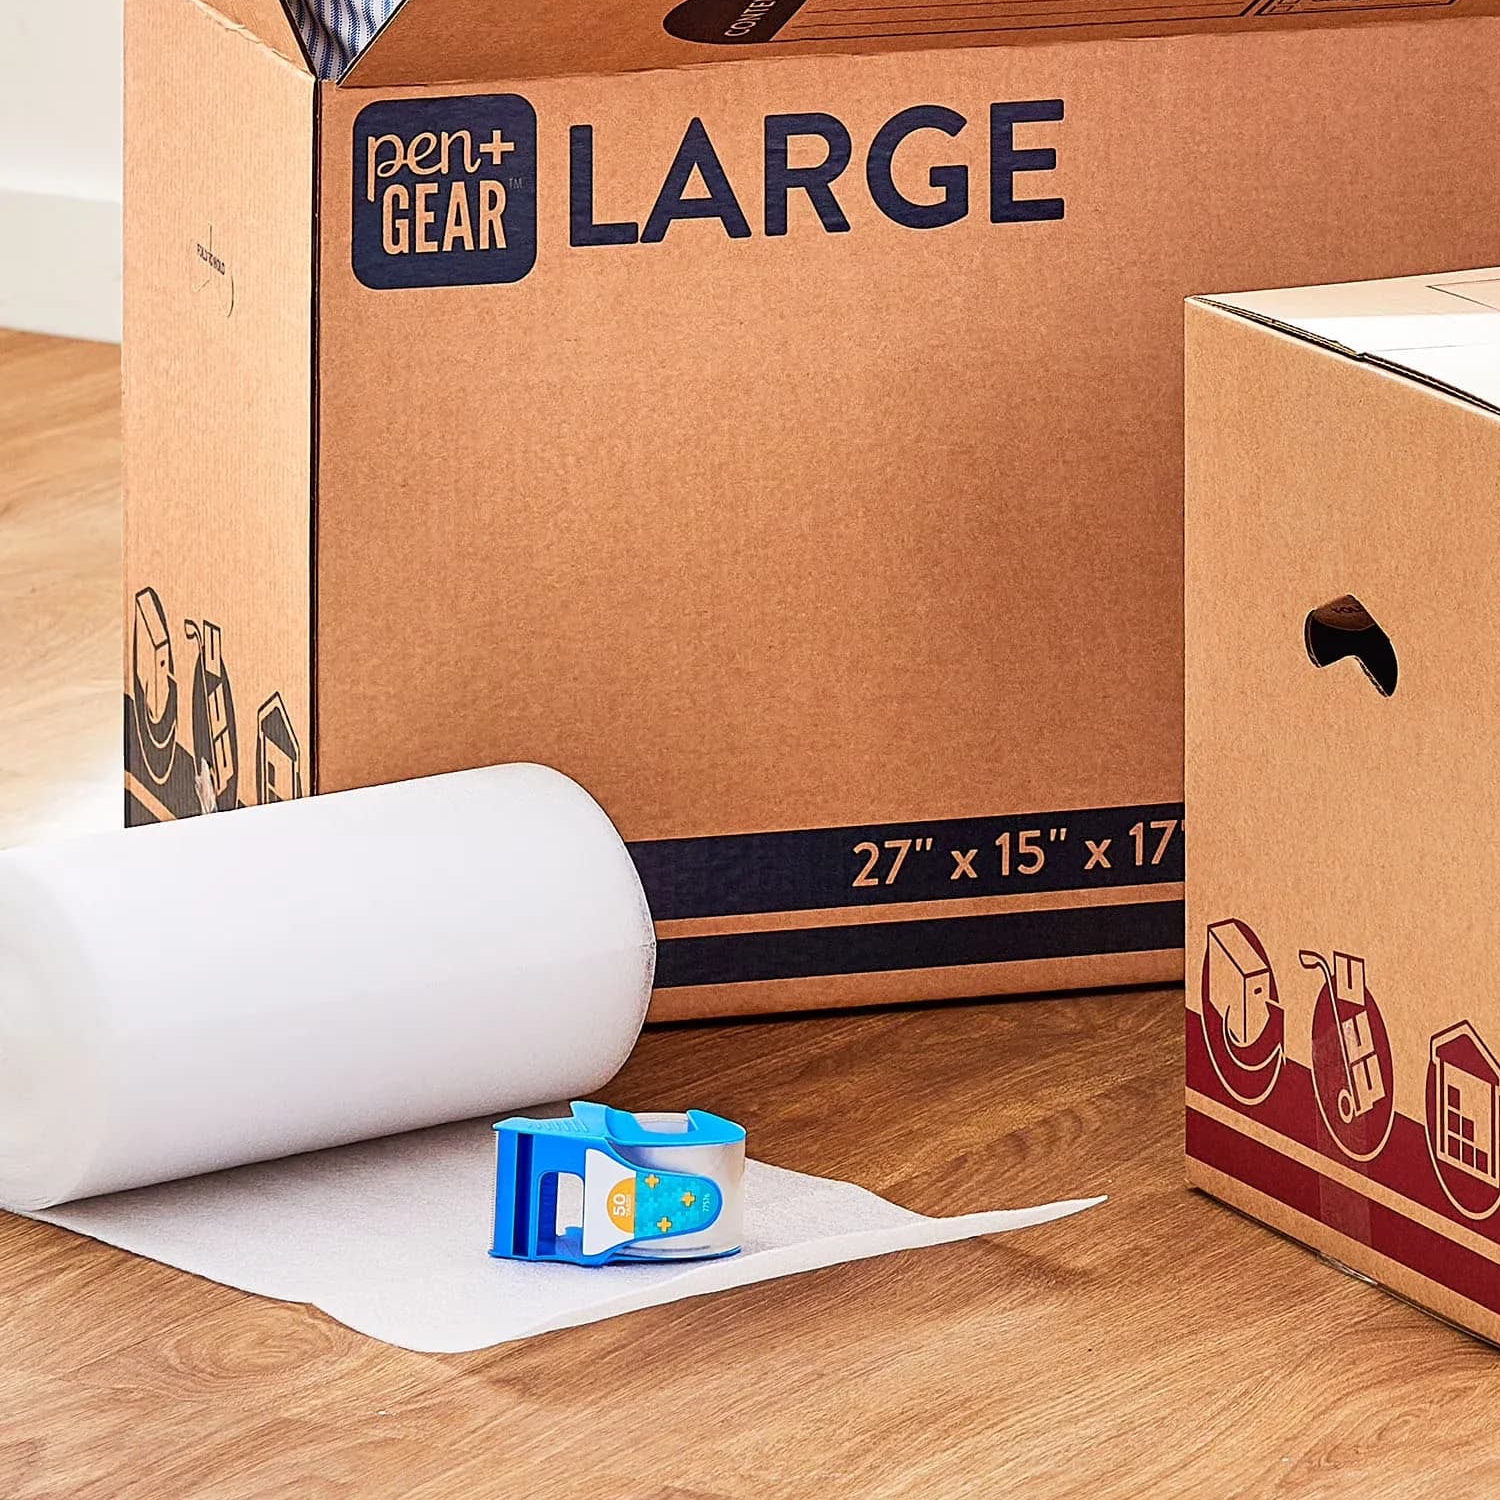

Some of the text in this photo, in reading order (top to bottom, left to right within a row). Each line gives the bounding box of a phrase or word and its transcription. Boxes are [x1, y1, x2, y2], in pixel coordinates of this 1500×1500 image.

[569, 98, 1065, 248] LARGE
[381, 178, 508, 256] GEAR
[852, 818, 1185, 887] 27" x 15" x 17
[613, 1193, 626, 1217] 50
